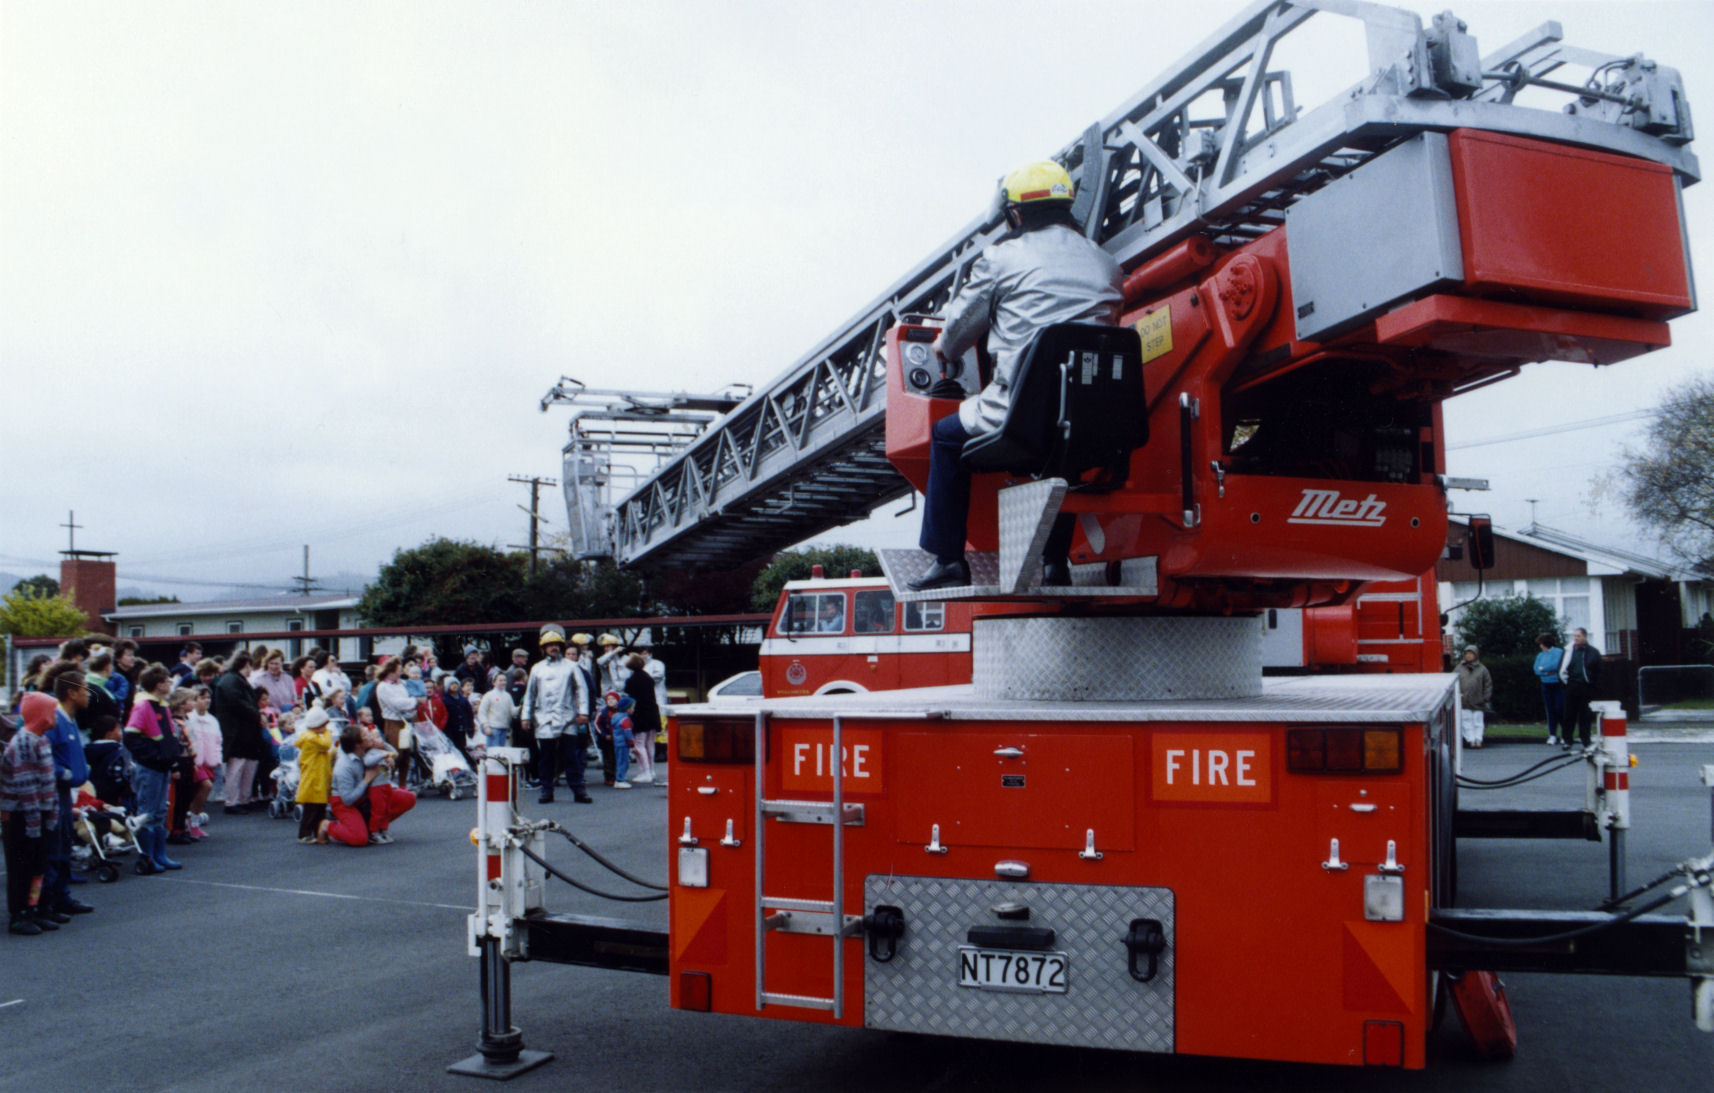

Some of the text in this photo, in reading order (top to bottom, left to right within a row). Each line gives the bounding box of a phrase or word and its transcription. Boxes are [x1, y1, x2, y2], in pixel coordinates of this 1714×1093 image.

[1152, 315, 1167, 331] NOT
[1146, 335, 1164, 352] STEP
[1288, 489, 1387, 524] Metz
[794, 743, 870, 778] FIRE
[1166, 749, 1256, 786] FIRE
[961, 952, 1065, 987] NT7872
